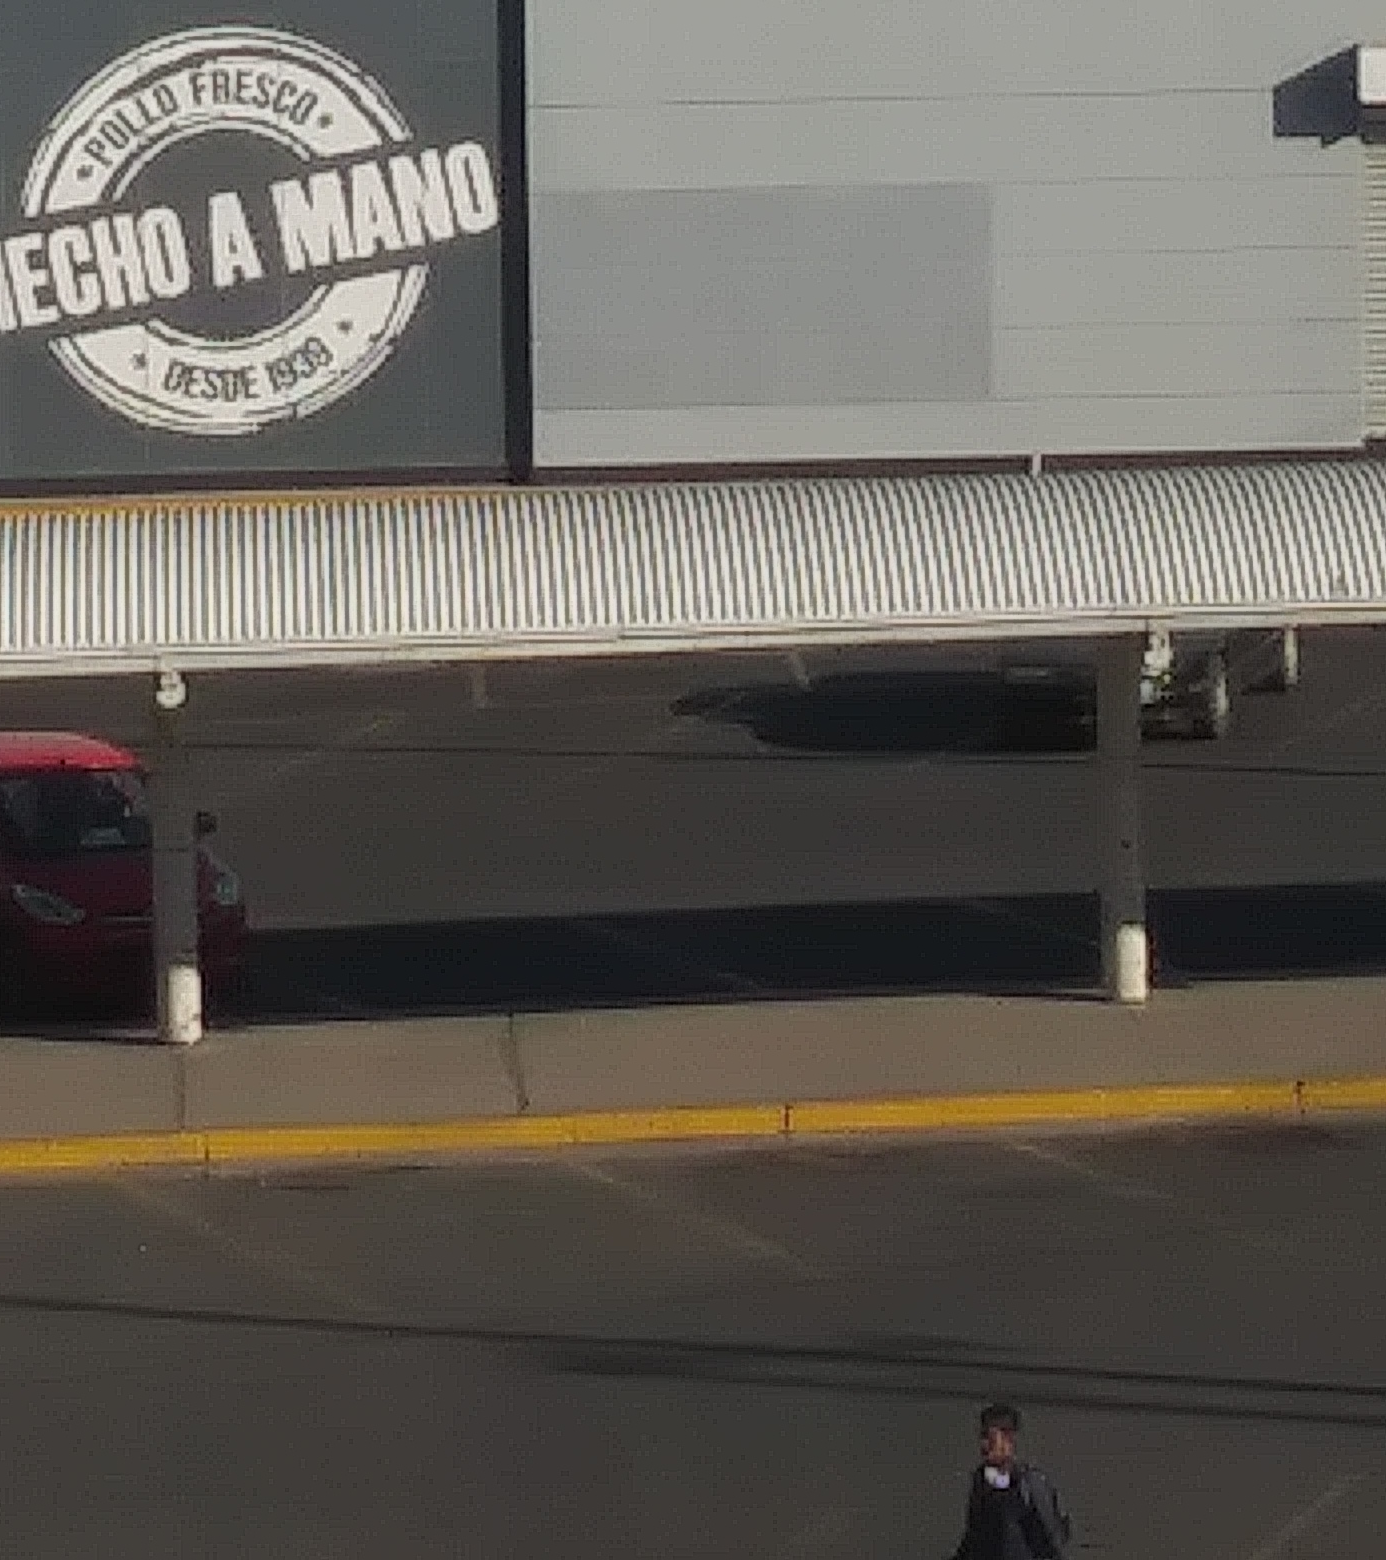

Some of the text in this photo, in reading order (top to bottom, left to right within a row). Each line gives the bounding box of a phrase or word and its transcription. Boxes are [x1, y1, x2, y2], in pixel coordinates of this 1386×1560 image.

[83, 67, 319, 168] POLLO FRESCO
[208, 191, 266, 287] A
[269, 141, 500, 274] MANO
[164, 358, 261, 403] DESDE
